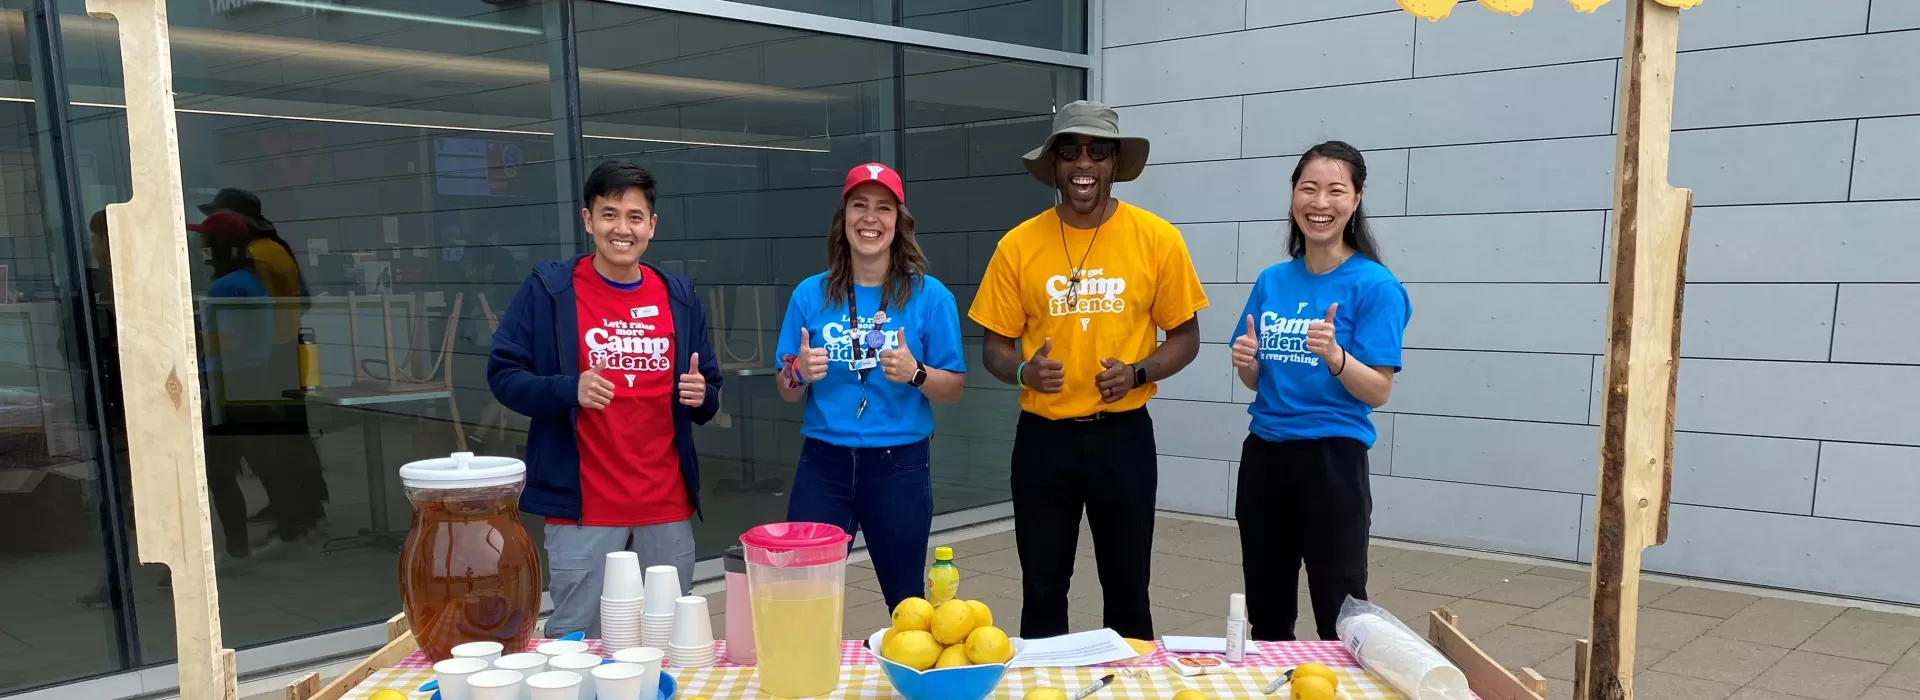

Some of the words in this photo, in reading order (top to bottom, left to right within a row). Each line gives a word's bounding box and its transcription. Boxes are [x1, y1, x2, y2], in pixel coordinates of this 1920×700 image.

[1088, 268, 1104, 278] got
[603, 318, 627, 328] Let's
[1260, 311, 1325, 334] Cam
[615, 328, 645, 336] more
[585, 327, 670, 360] Camp
